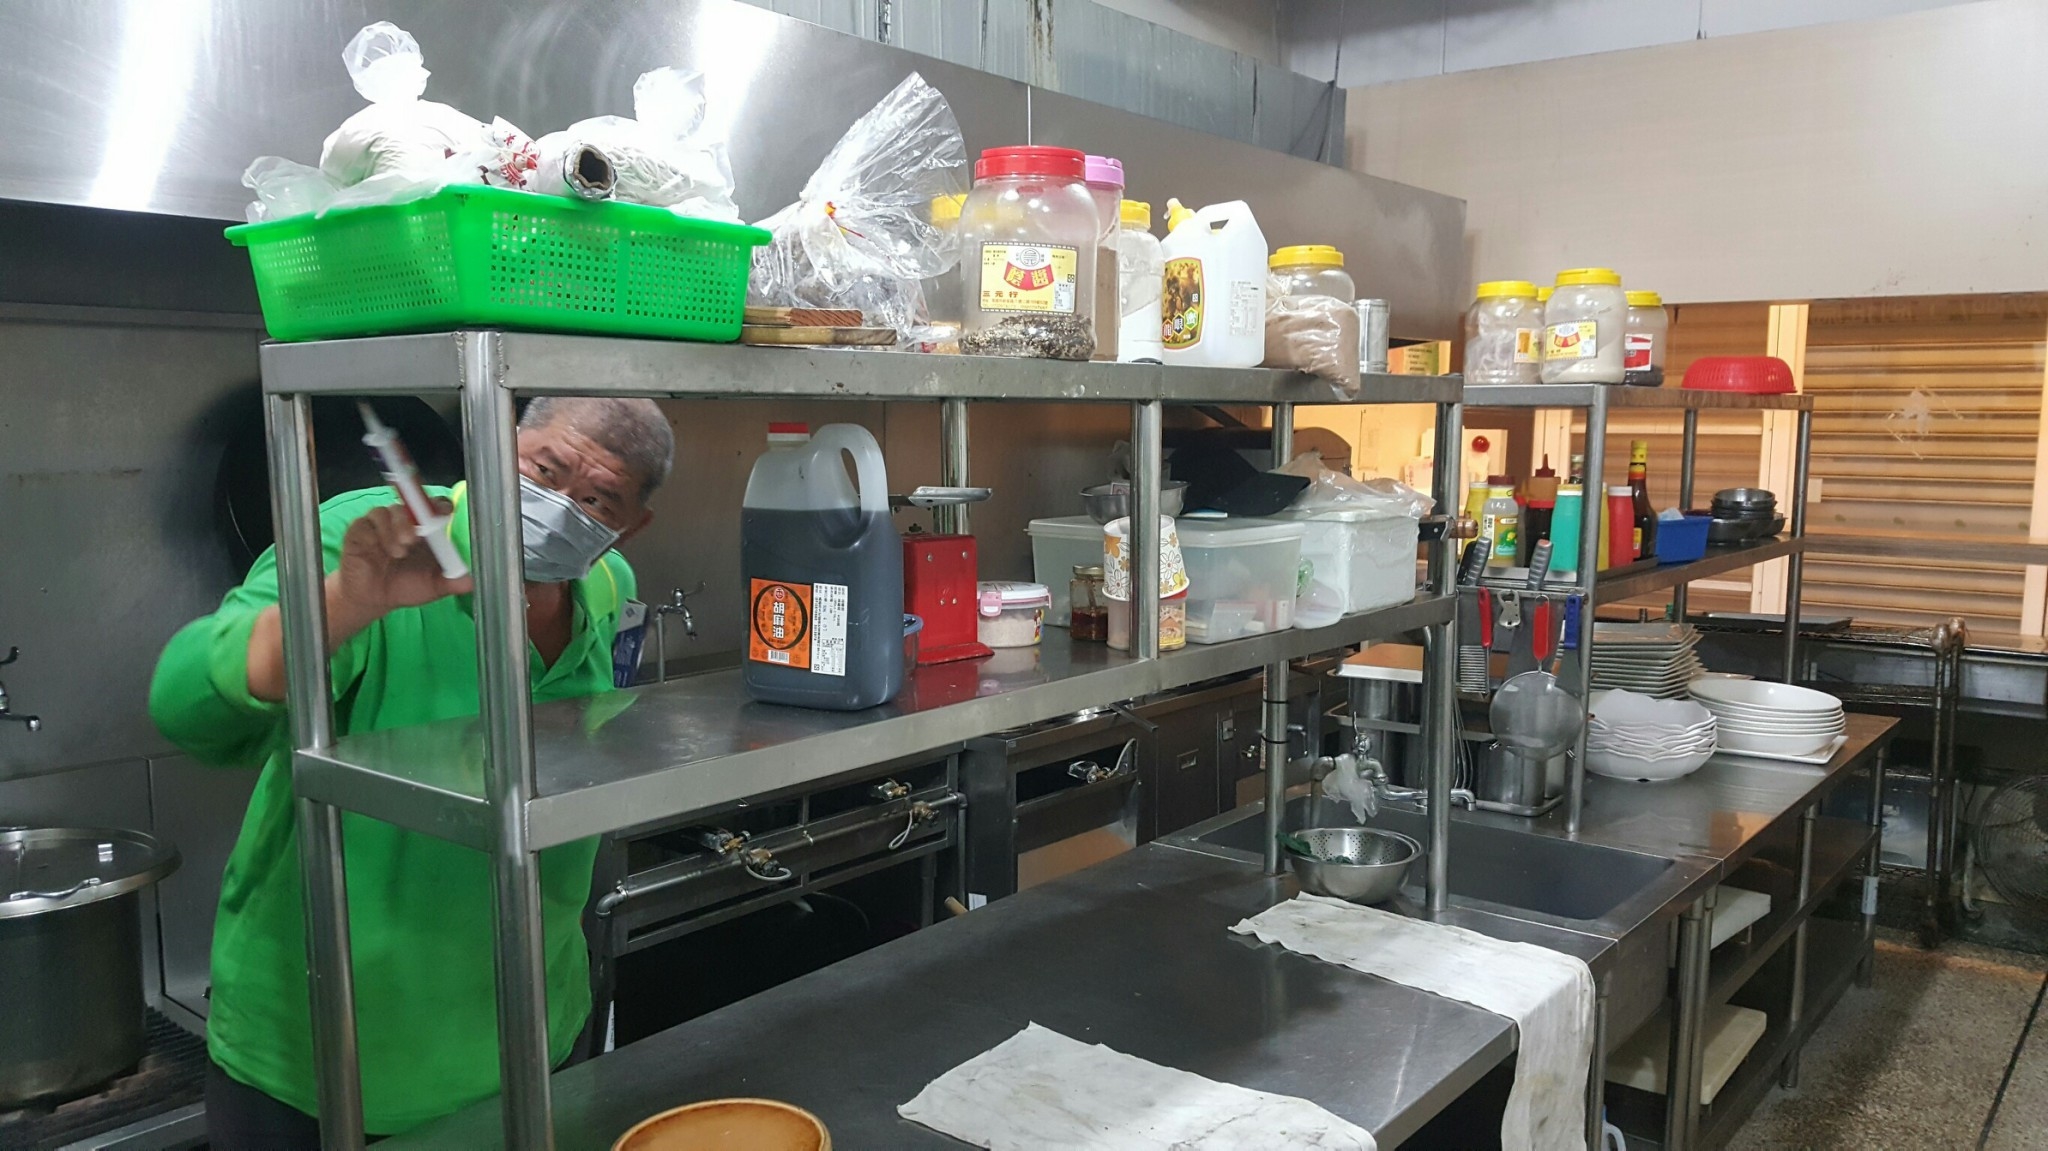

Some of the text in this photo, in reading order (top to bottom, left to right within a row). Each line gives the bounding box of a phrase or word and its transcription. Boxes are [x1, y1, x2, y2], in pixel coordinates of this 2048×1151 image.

[983, 290, 1019, 298] 三元行
[773, 602, 785, 638] 胡麻油
